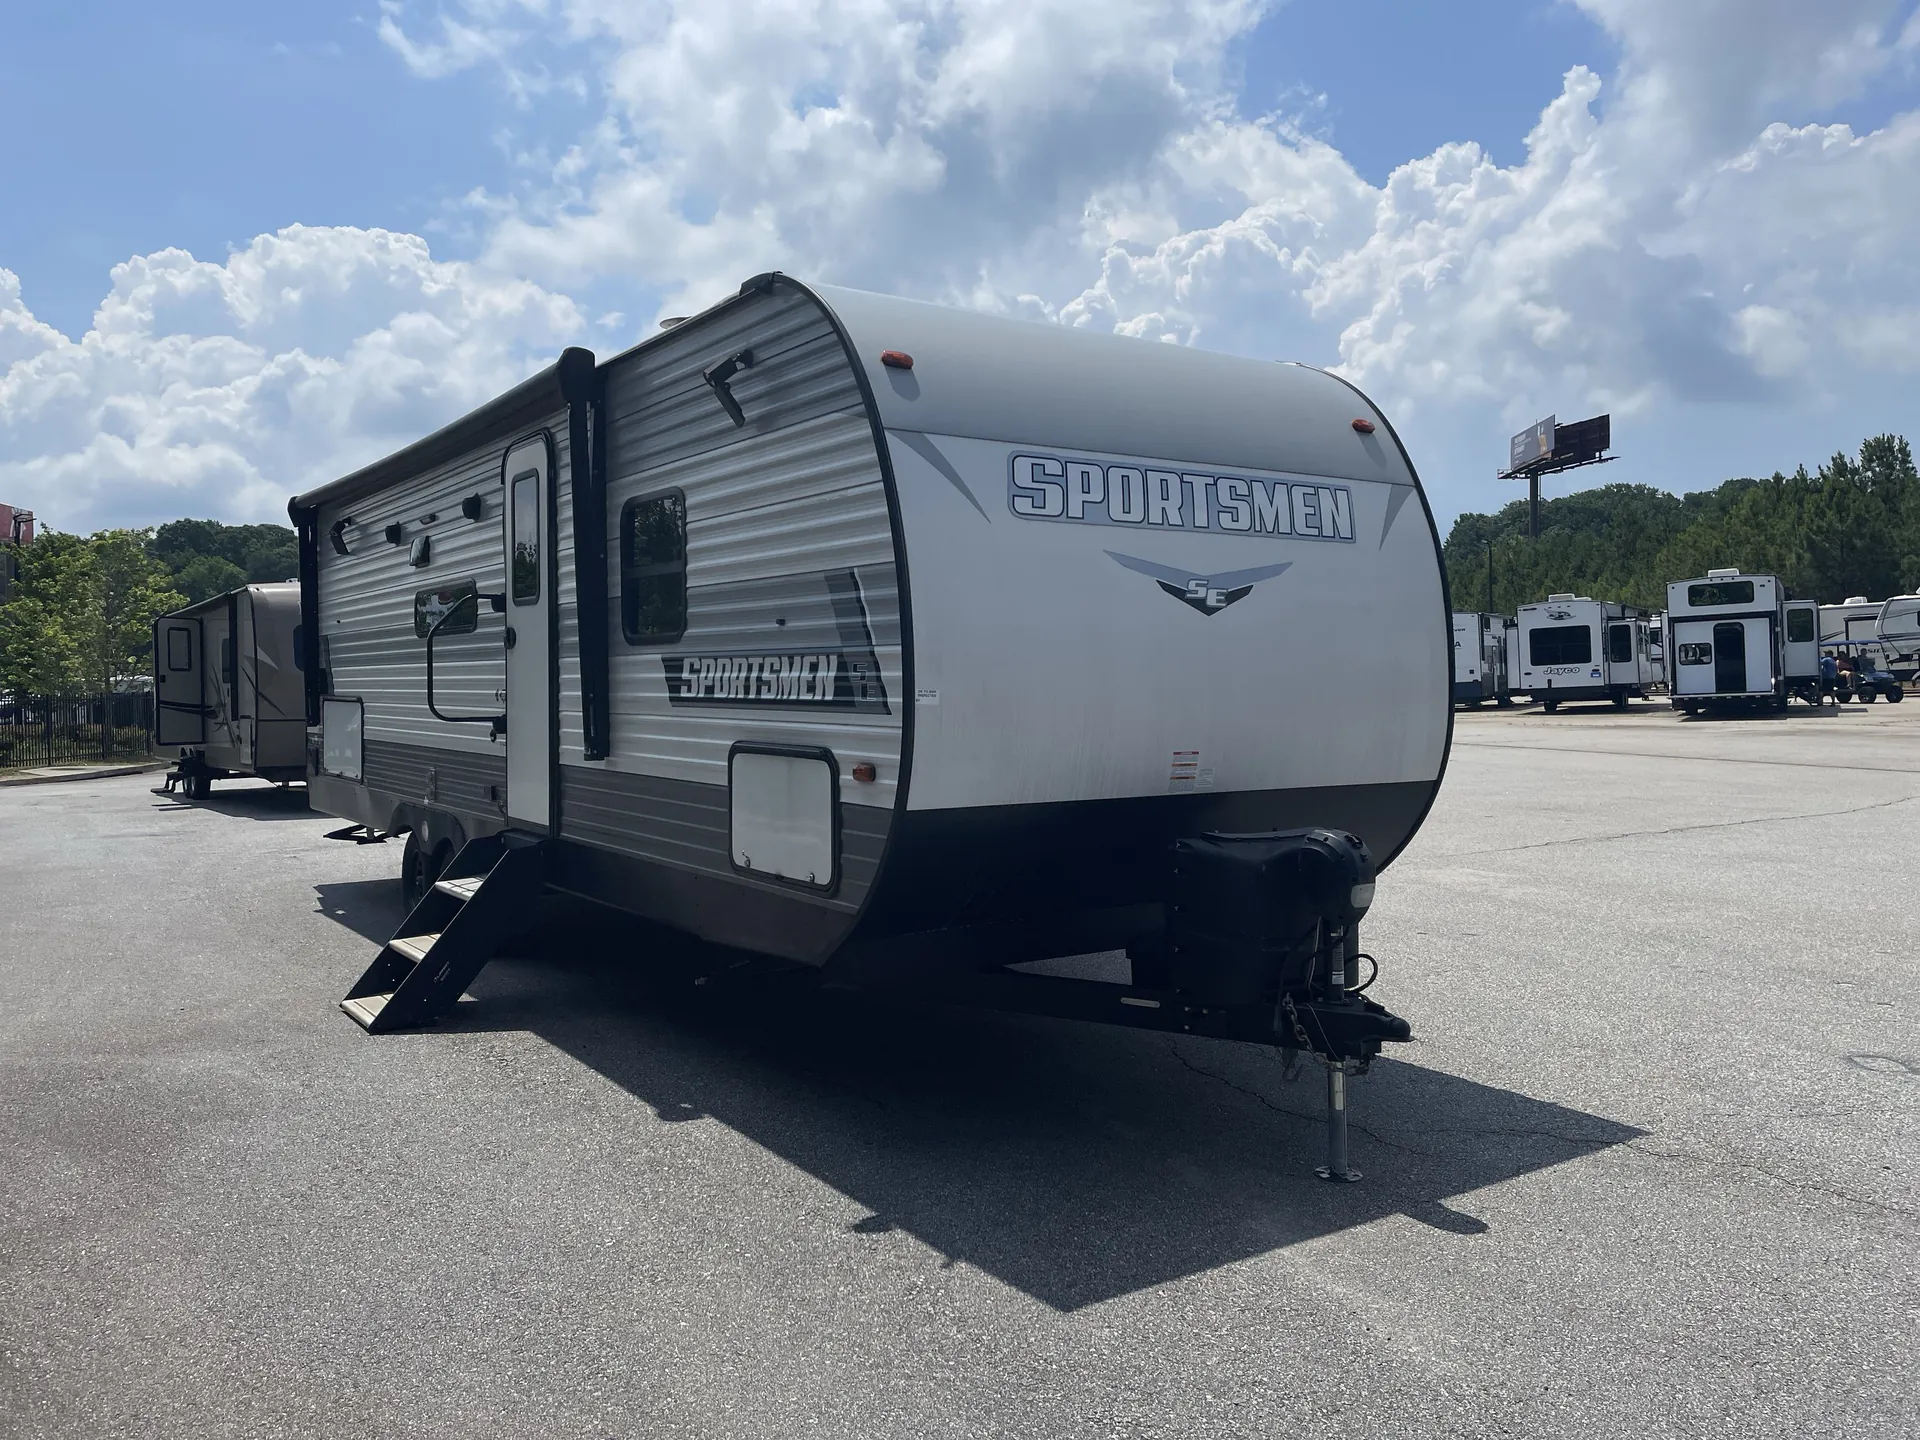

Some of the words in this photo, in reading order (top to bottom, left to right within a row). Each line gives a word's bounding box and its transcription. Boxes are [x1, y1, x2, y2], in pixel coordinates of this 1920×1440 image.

[1012, 455, 1354, 540] SPORTSMEN
[1185, 579, 1229, 608] SE
[680, 655, 838, 701] SPORTSMEN
[851, 662, 877, 702] SE
[1543, 667, 1580, 675] Jayco
